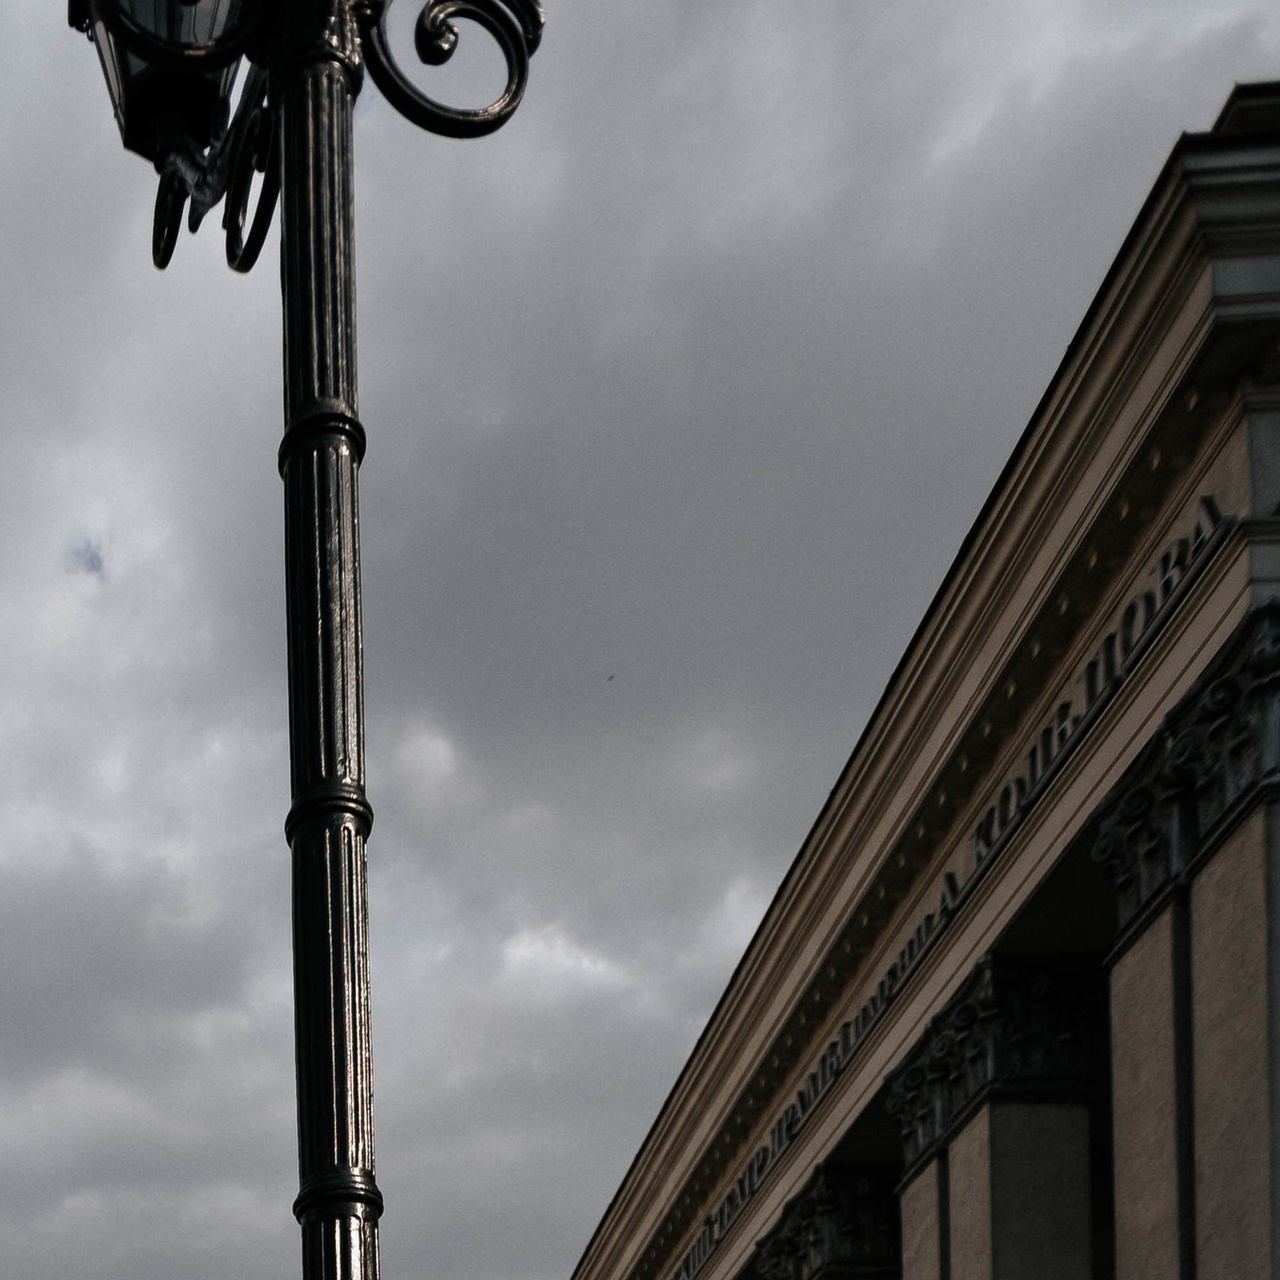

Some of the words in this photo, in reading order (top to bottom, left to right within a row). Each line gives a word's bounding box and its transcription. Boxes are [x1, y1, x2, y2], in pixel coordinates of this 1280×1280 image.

[717, 1144, 769, 1231] ТЕАТР
[770, 1021, 854, 1162] ДРАМЫ
[854, 913, 935, 1039] ИМЕНИ
[971, 495, 1224, 866] КОЛЬЦОВА
